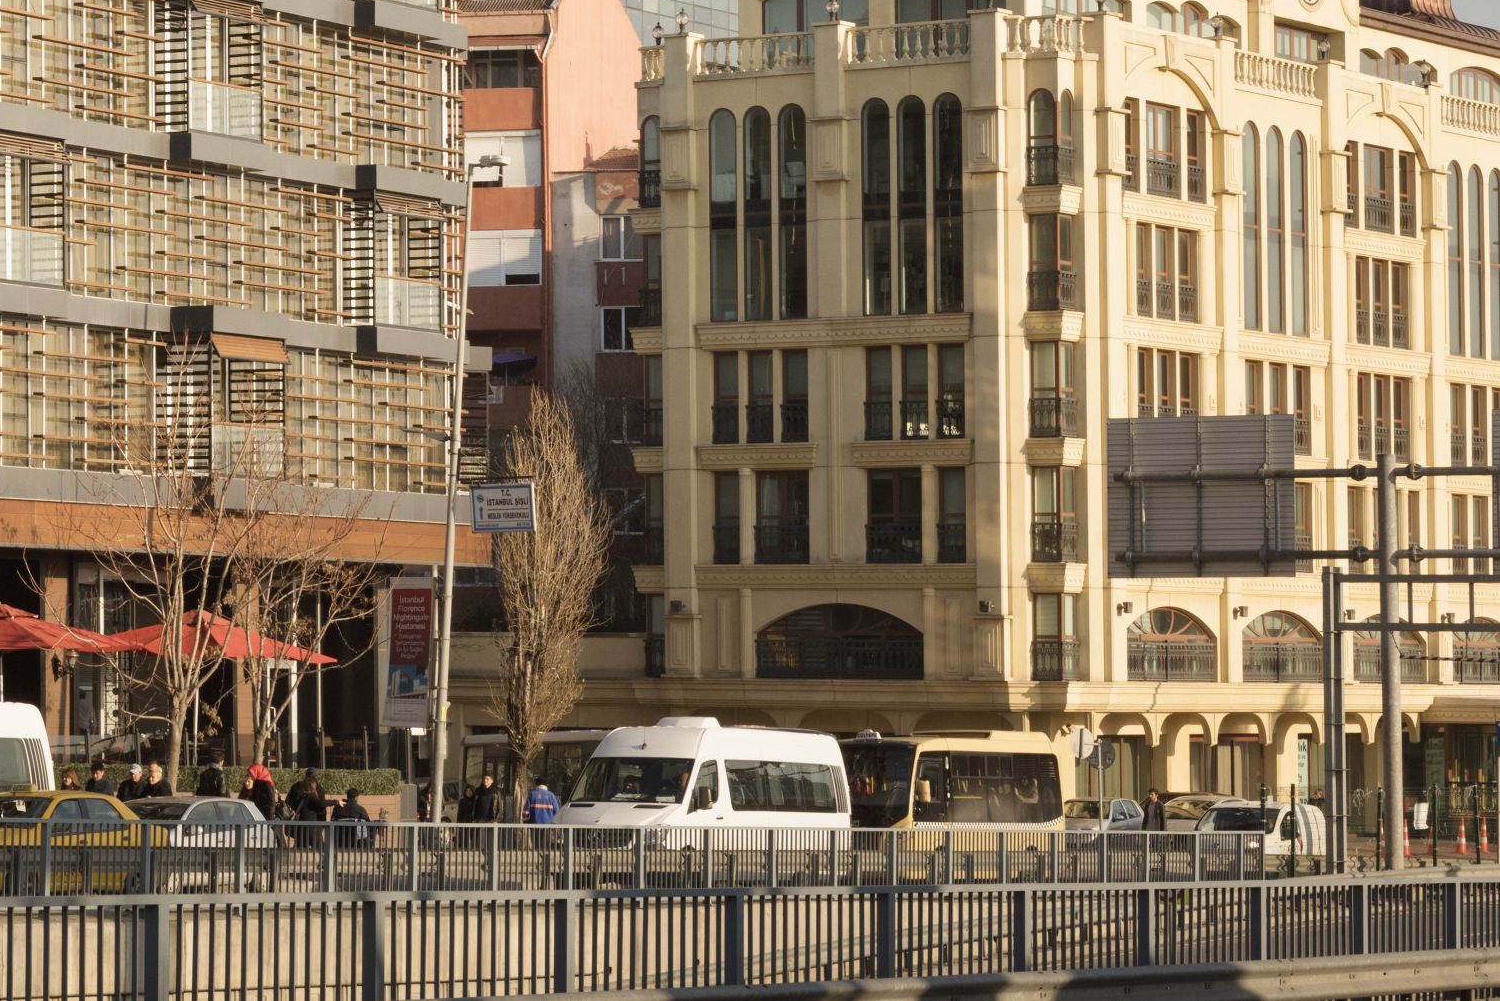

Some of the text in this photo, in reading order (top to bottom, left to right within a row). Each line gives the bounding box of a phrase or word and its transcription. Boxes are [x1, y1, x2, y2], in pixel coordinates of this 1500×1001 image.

[486, 497, 514, 506] İSTANBUL
[393, 613, 430, 622] Nightingale
[395, 622, 426, 630] Hastanesi
